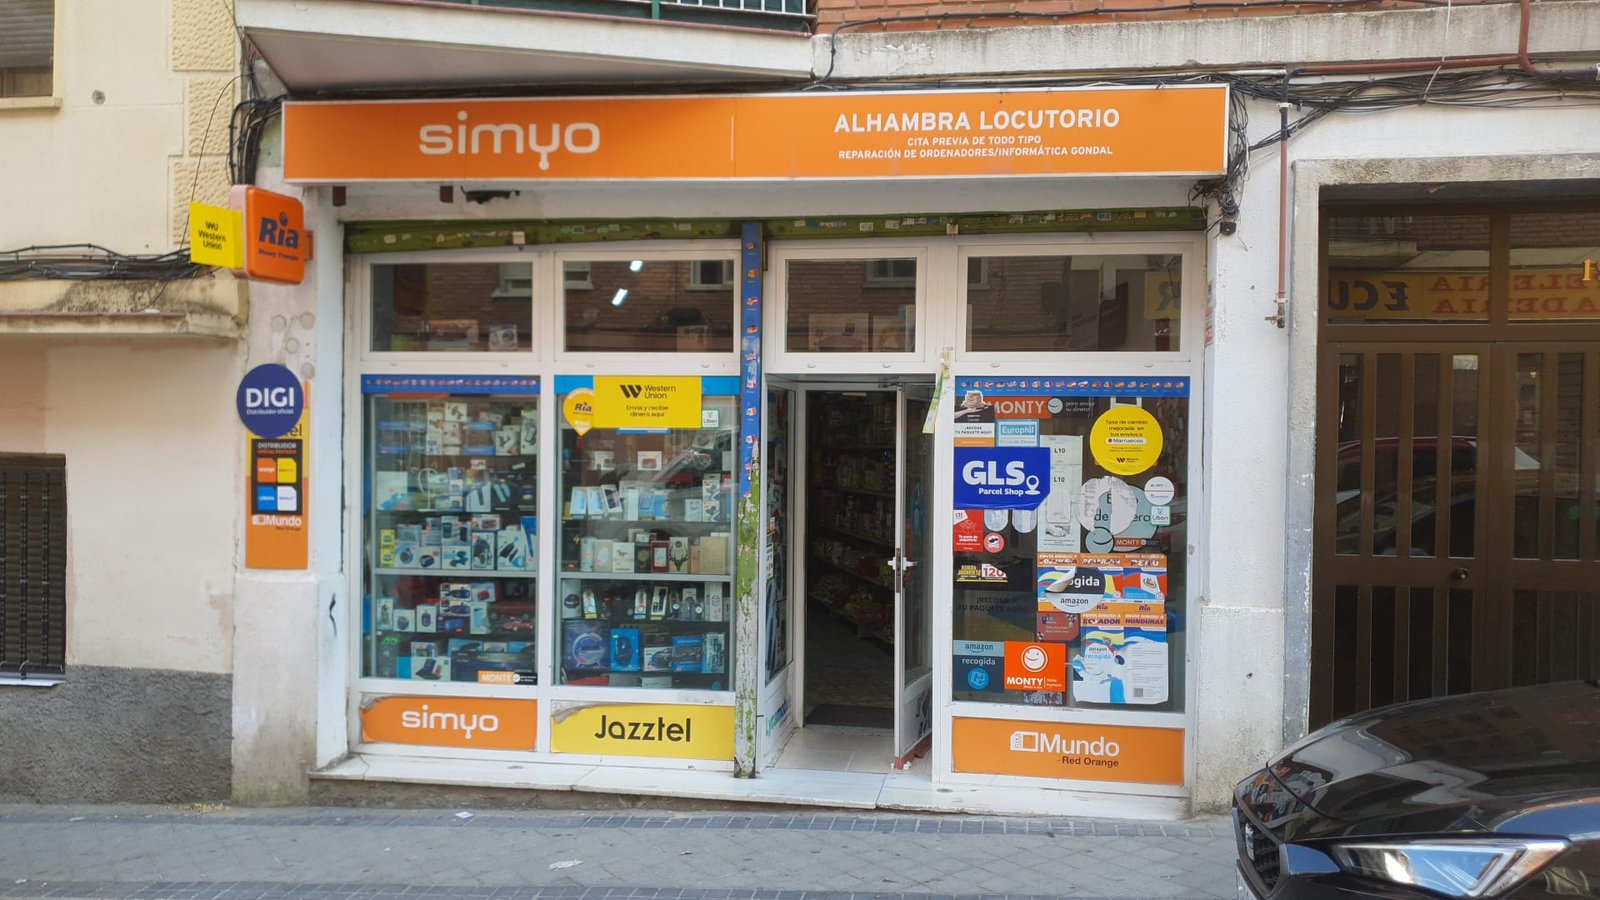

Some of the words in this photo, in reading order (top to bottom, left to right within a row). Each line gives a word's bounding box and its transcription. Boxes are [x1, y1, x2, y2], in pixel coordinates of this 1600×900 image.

[834, 111, 972, 133] ALHAMBRA
[979, 108, 1121, 131] LOCUTORIO
[419, 110, 601, 170] simyo
[907, 138, 930, 147] CITA
[932, 137, 970, 146] PREVIA
[972, 137, 986, 145] DE
[988, 136, 1016, 145] TODO
[1018, 135, 1042, 144] TIPO
[838, 148, 901, 159] REPARACIÓN
[904, 149, 917, 158] DE
[919, 145, 1068, 158] ORDENADORES/INFORMÁTICA
[1071, 146, 1113, 155] GONDAL
[198, 229, 227, 243] Western
[258, 211, 300, 250] Ria
[203, 239, 223, 251] Union
[644, 384, 677, 392] Western
[246, 386, 295, 408] DIGI
[644, 392, 668, 400] Union
[574, 401, 593, 412] Ria
[993, 400, 1045, 415] MONTY
[1001, 426, 1035, 436] Europhil
[962, 460, 1026, 486] GLS
[978, 487, 1003, 496] Parcel
[1004, 488, 1024, 497] Shop
[265, 515, 302, 527] Mundo
[1068, 575, 1100, 588] ogida
[1060, 597, 1089, 605] amazon
[965, 643, 994, 651] amazon
[962, 657, 996, 667] recogida
[1007, 676, 1043, 687] MONTY
[401, 704, 499, 739] simyo
[594, 714, 691, 744] Jazztel
[1040, 732, 1120, 757] Mundo
[1061, 756, 1082, 765] Red
[1083, 757, 1119, 767] Orange
